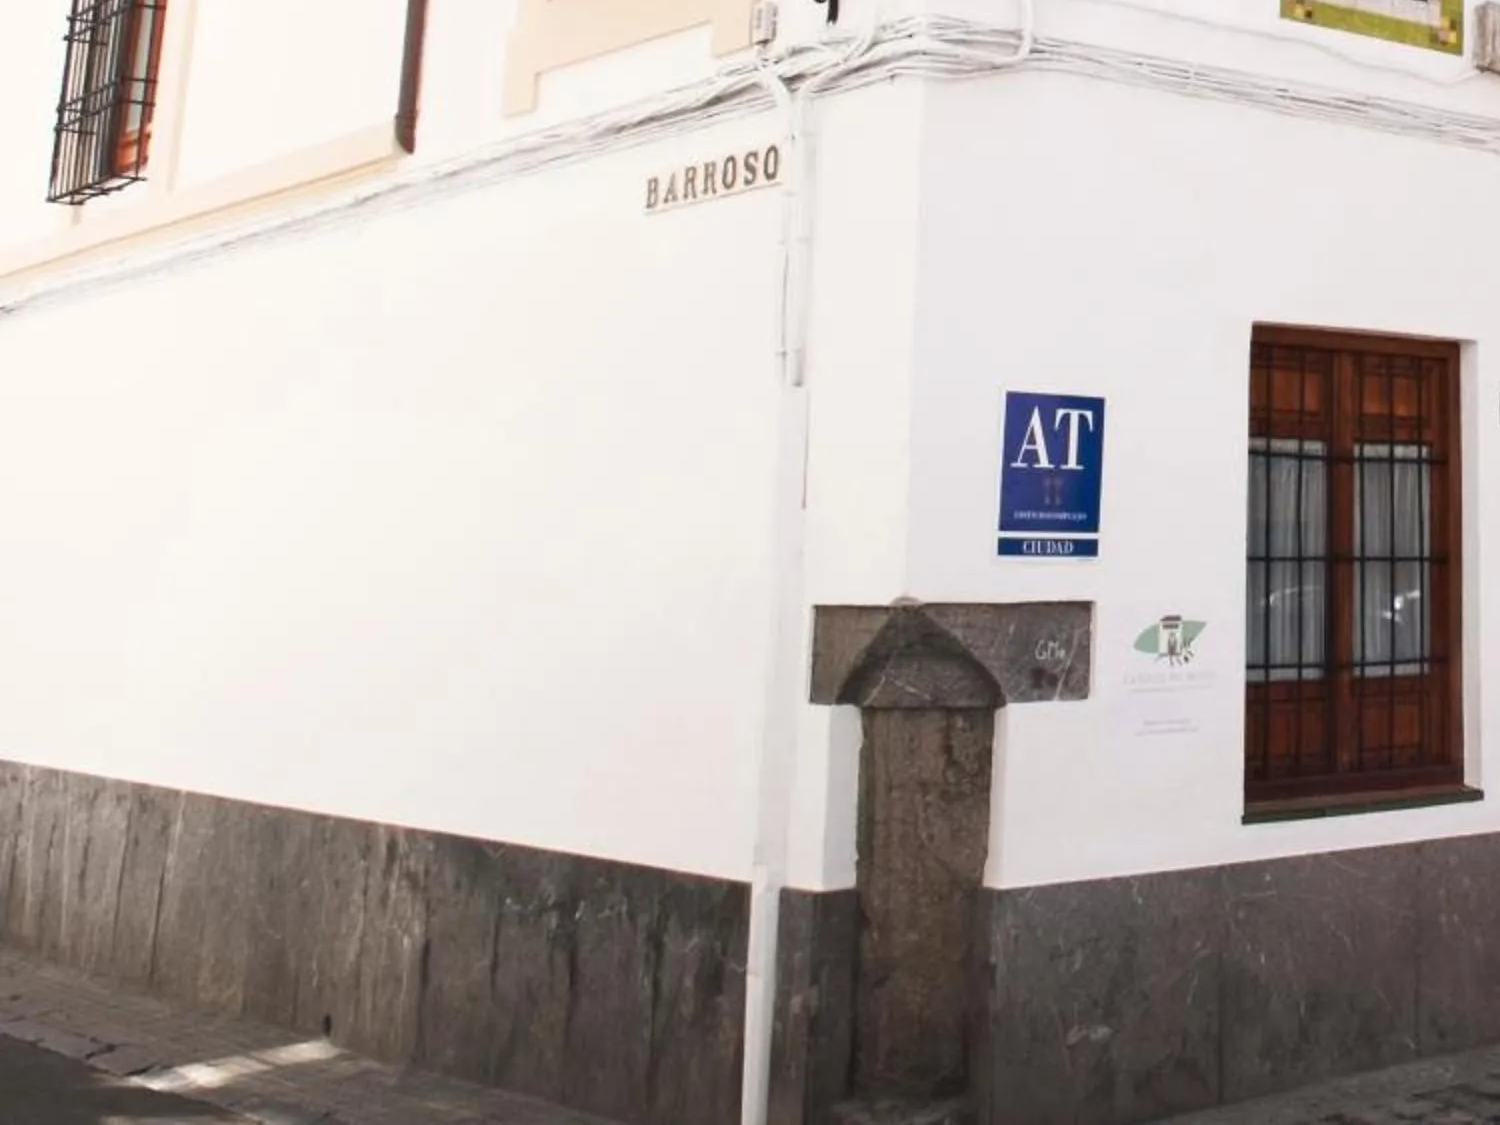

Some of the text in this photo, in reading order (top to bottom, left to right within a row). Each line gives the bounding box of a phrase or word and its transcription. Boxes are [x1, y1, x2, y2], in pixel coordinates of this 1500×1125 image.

[645, 144, 780, 210] BARROSO
[1010, 404, 1094, 471] AT
[1022, 539, 1075, 555] CIUDAD
